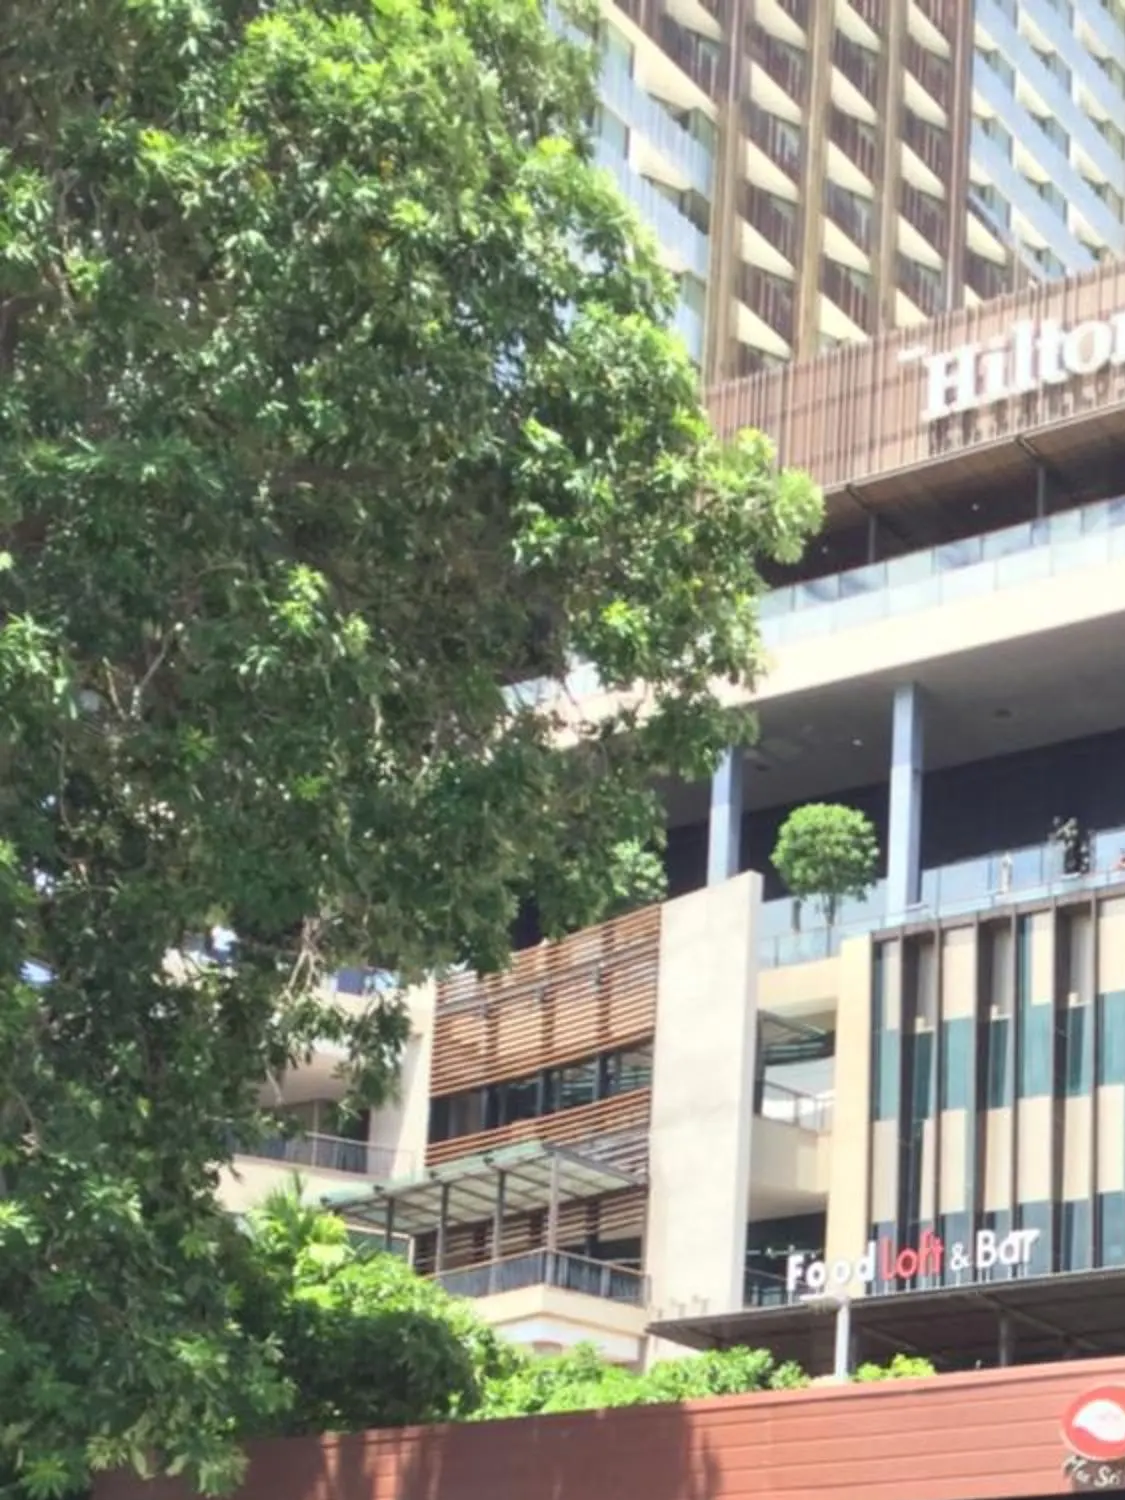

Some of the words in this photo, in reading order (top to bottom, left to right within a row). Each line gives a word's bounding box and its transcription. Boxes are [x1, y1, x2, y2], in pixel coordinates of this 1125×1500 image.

[786, 1240, 876, 1291] Food
[879, 1228, 944, 1281] Loft
[950, 1243, 971, 1271] &
[976, 1228, 1040, 1268] Bar
